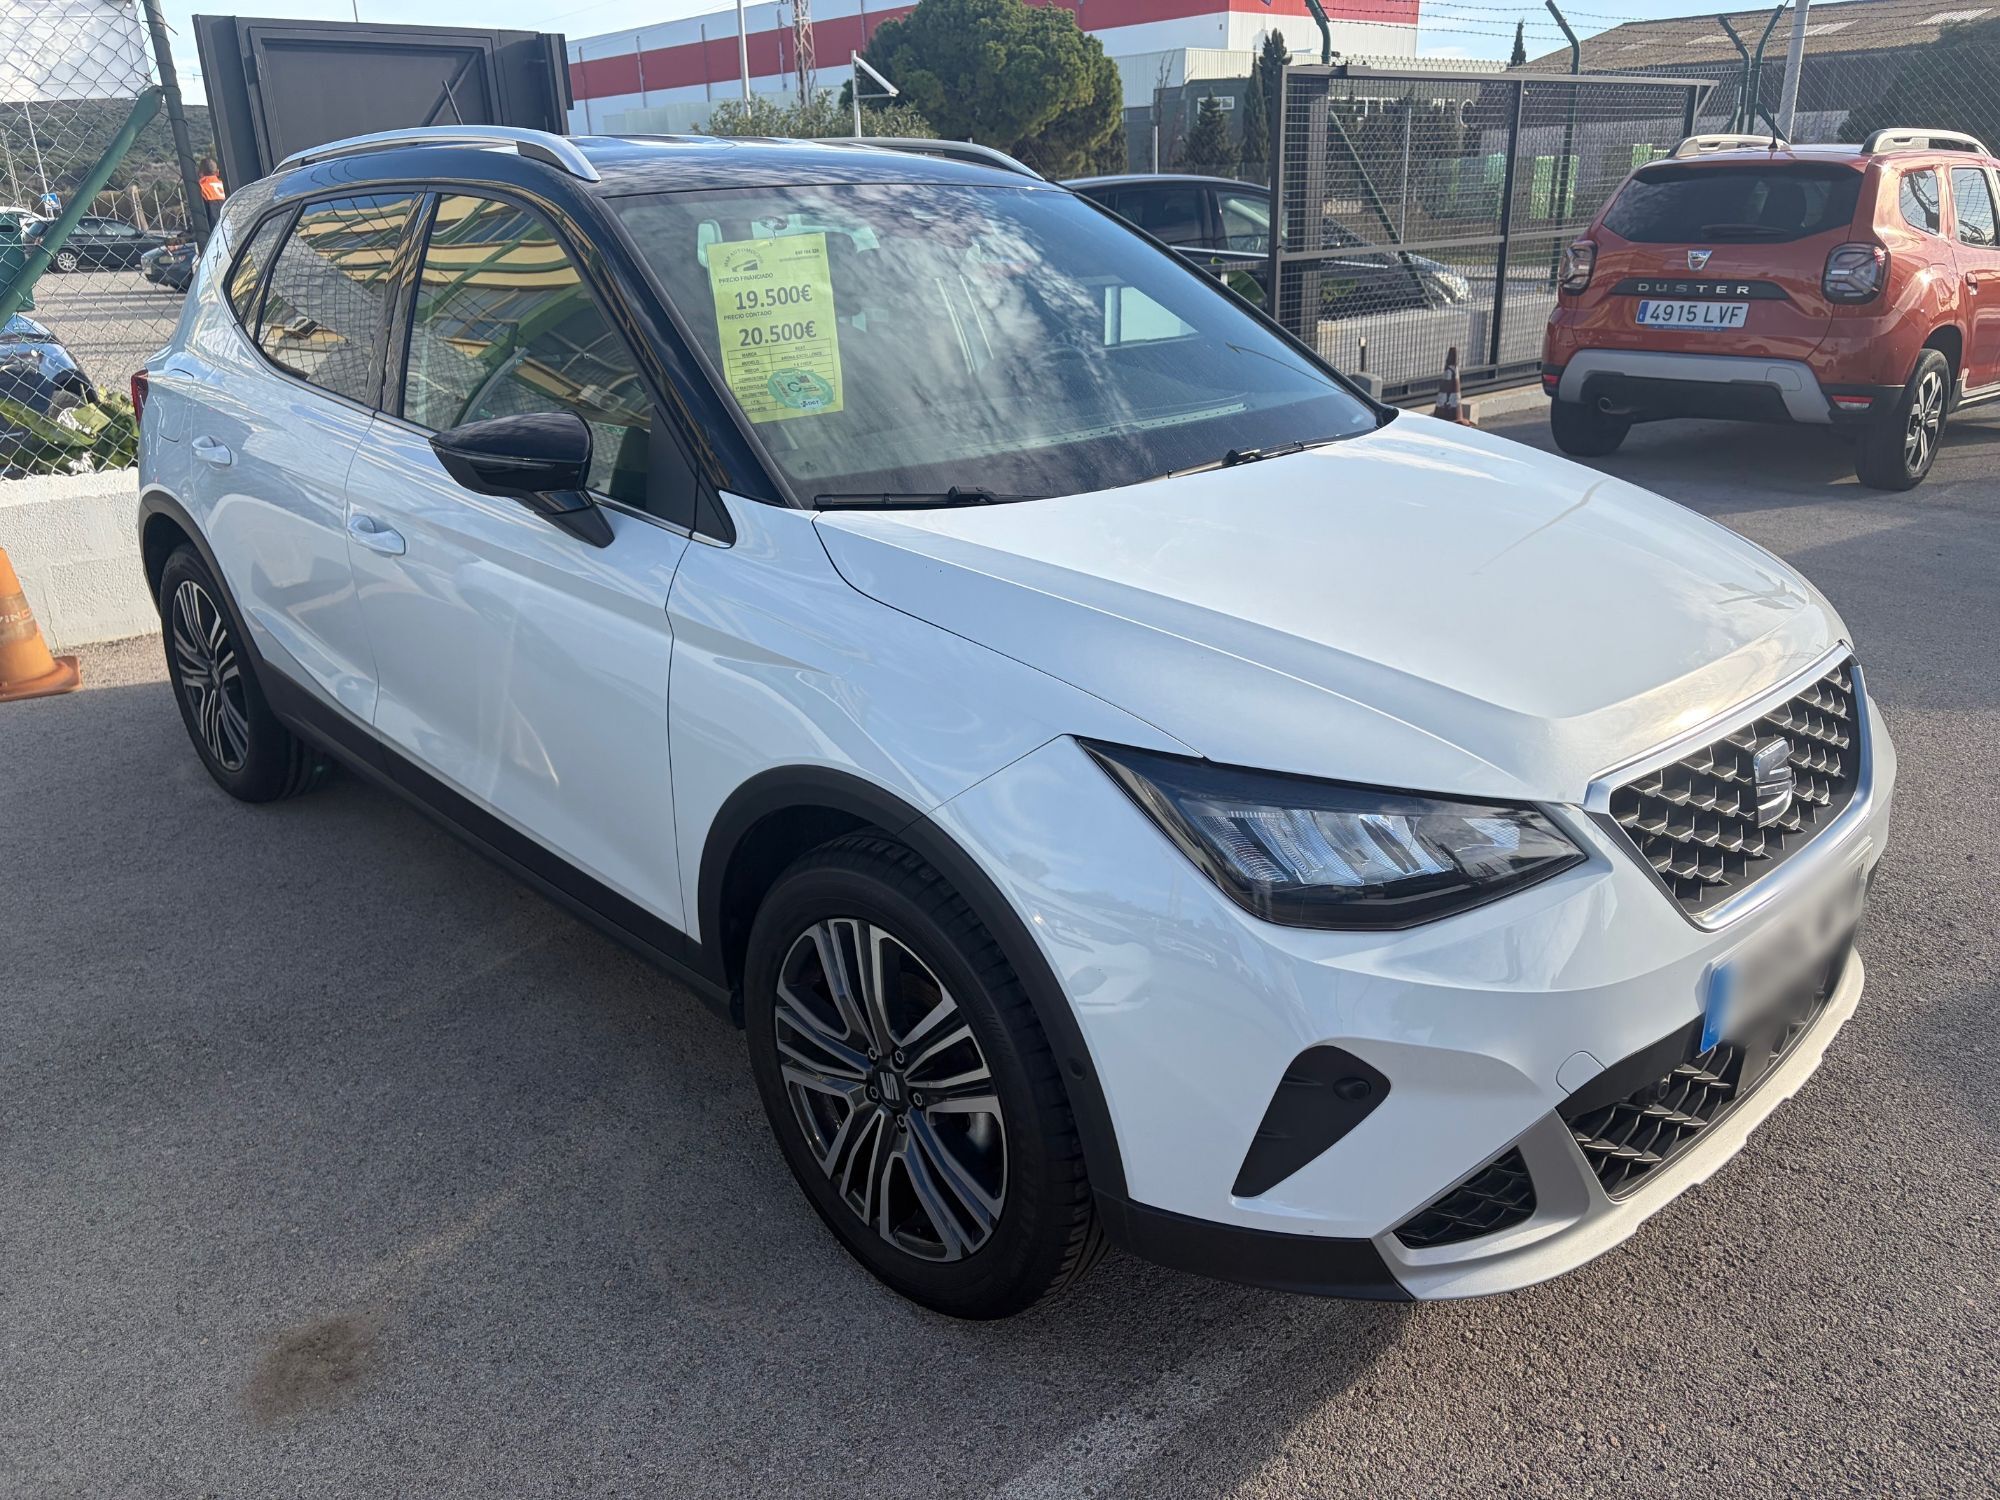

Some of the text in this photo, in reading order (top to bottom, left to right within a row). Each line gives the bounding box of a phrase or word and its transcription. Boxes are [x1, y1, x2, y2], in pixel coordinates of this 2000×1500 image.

[718, 272, 773, 284] PRECIO FINANCIADO
[1637, 283, 1750, 294] DUSTER
[735, 284, 813, 311] 19.500€
[723, 310, 772, 321] PRECIO CONTADO
[1650, 304, 1743, 324] 4915 LVF
[739, 320, 817, 347] 20.500€
